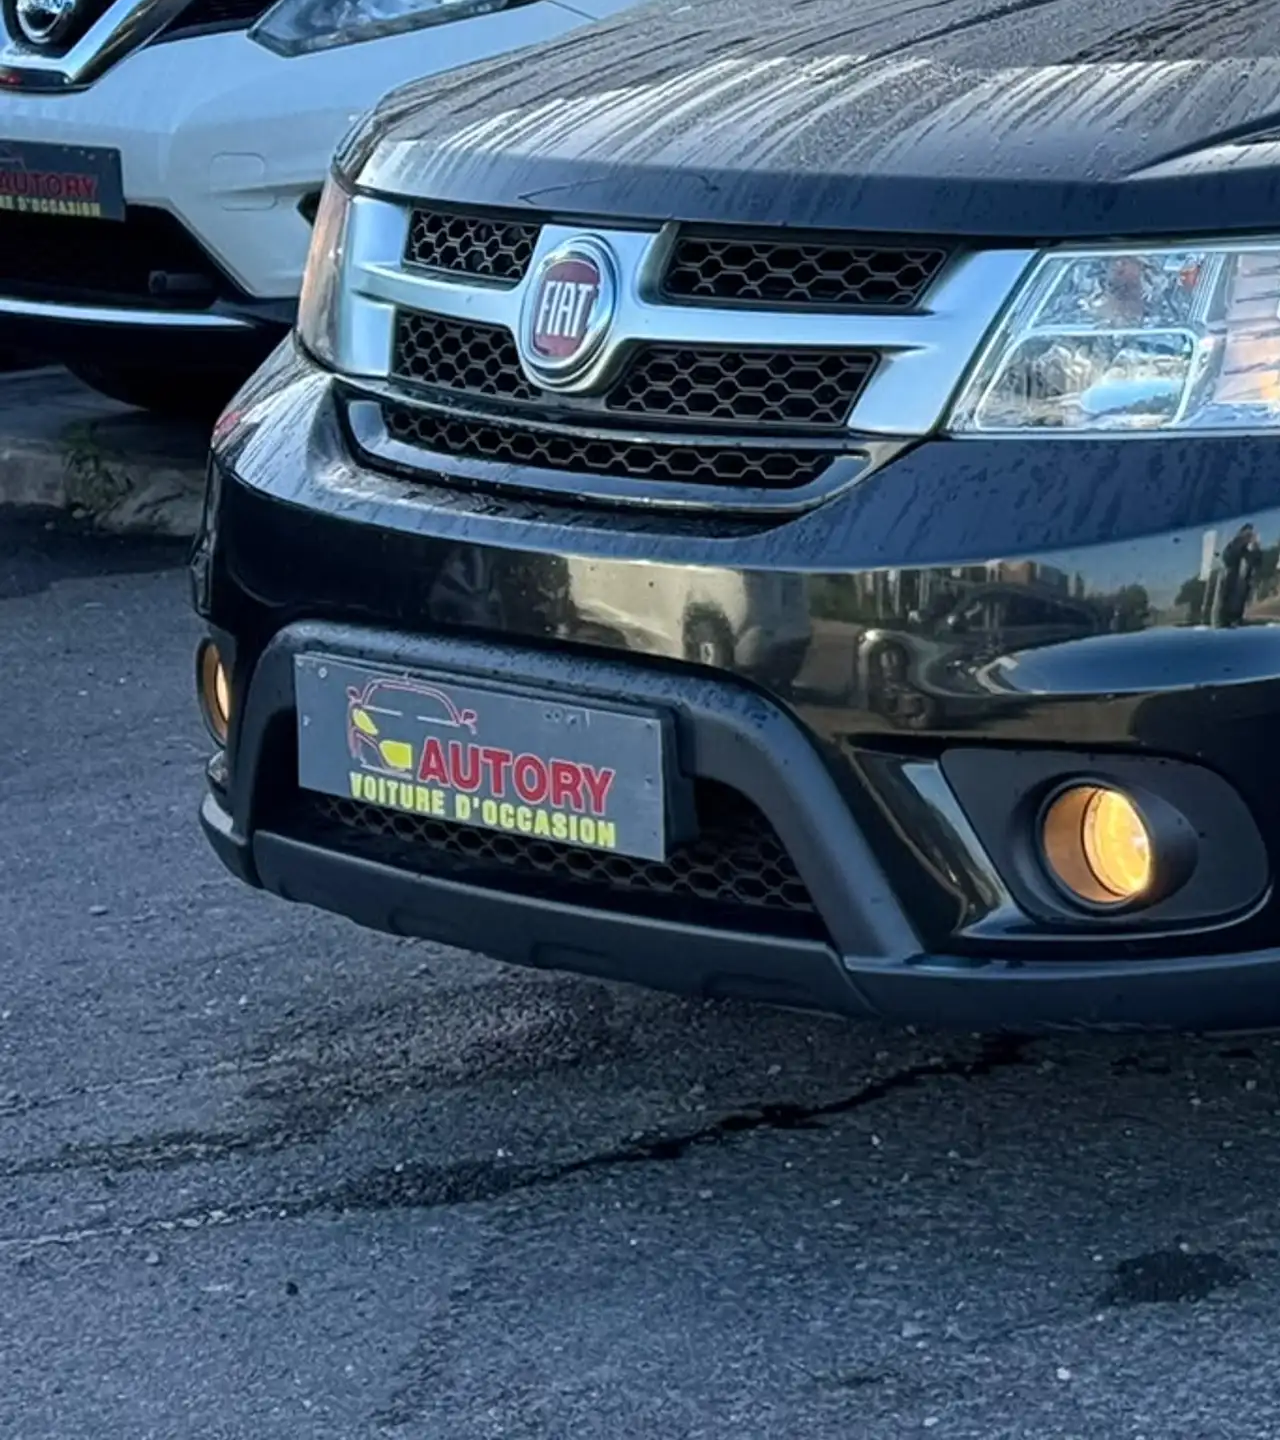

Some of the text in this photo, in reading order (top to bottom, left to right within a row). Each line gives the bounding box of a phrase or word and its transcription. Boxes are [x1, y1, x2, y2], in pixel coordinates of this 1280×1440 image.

[535, 280, 593, 338] FIAT
[350, 772, 616, 848] VOITURE D'OCCASION
[418, 737, 616, 815] AUTORY
